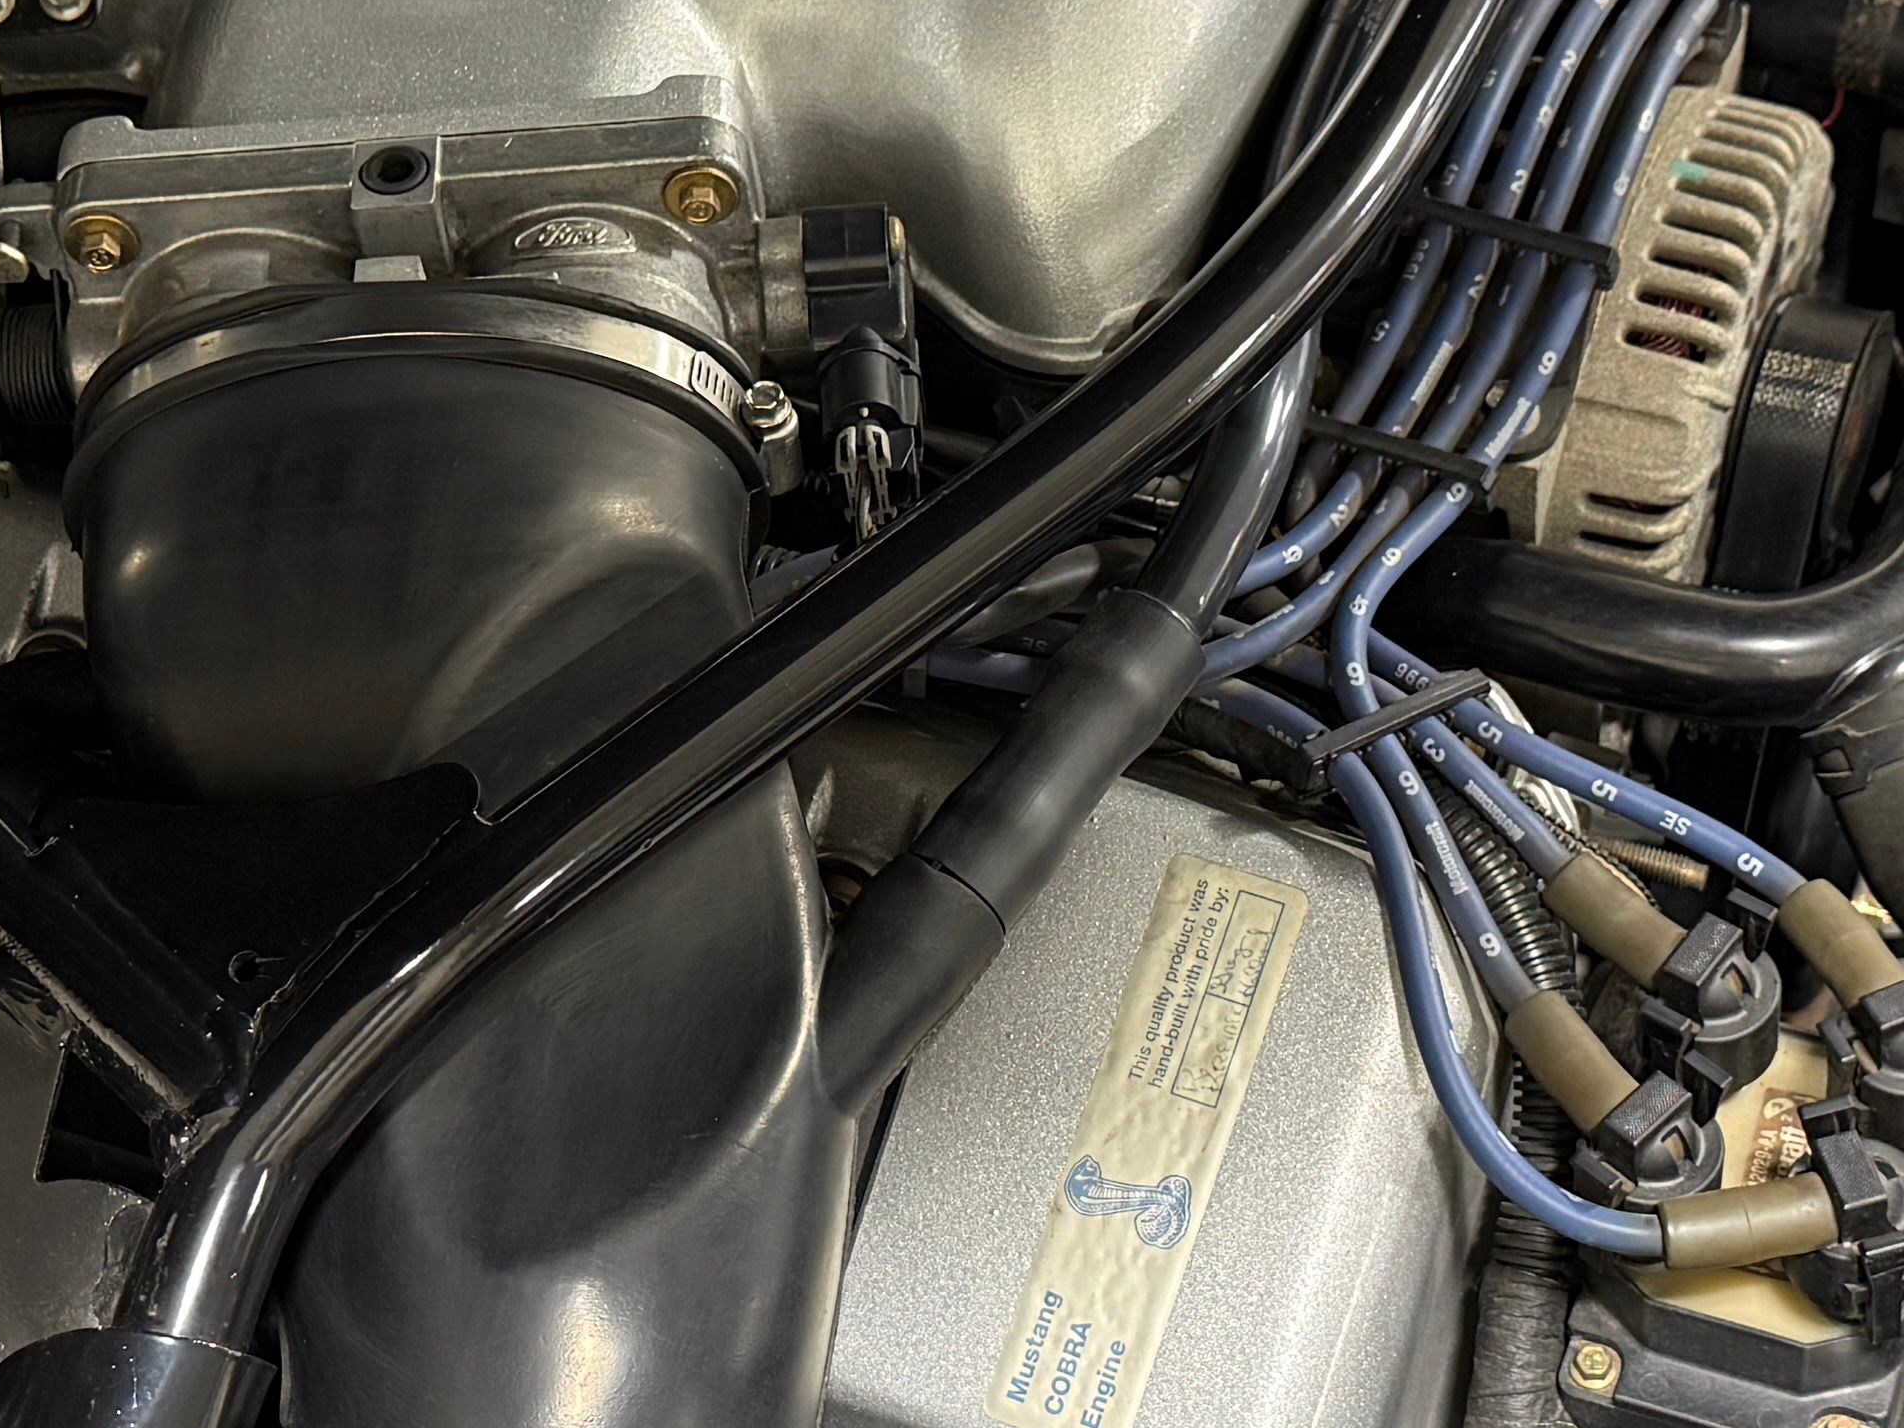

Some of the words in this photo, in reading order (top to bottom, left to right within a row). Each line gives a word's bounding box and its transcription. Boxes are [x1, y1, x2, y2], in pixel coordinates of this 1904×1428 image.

[1476, 719, 1504, 745] 5
[1590, 777, 1618, 803] 5
[1658, 809, 1692, 837] SE
[1424, 819, 1469, 896] Motorcraft
[1735, 851, 1764, 878] 5
[1127, 1043, 1153, 1082] This
[1141, 984, 1176, 1043] quality
[1162, 915, 1197, 983] product
[1186, 877, 1209, 913] was
[1147, 1001, 1190, 1089] hand-built
[1179, 962, 1204, 1000] with
[1193, 915, 1221, 961] pride
[1207, 884, 1232, 915] by:
[1004, 1287, 1065, 1405] Mustang
[1040, 1316, 1093, 1417] COBRA
